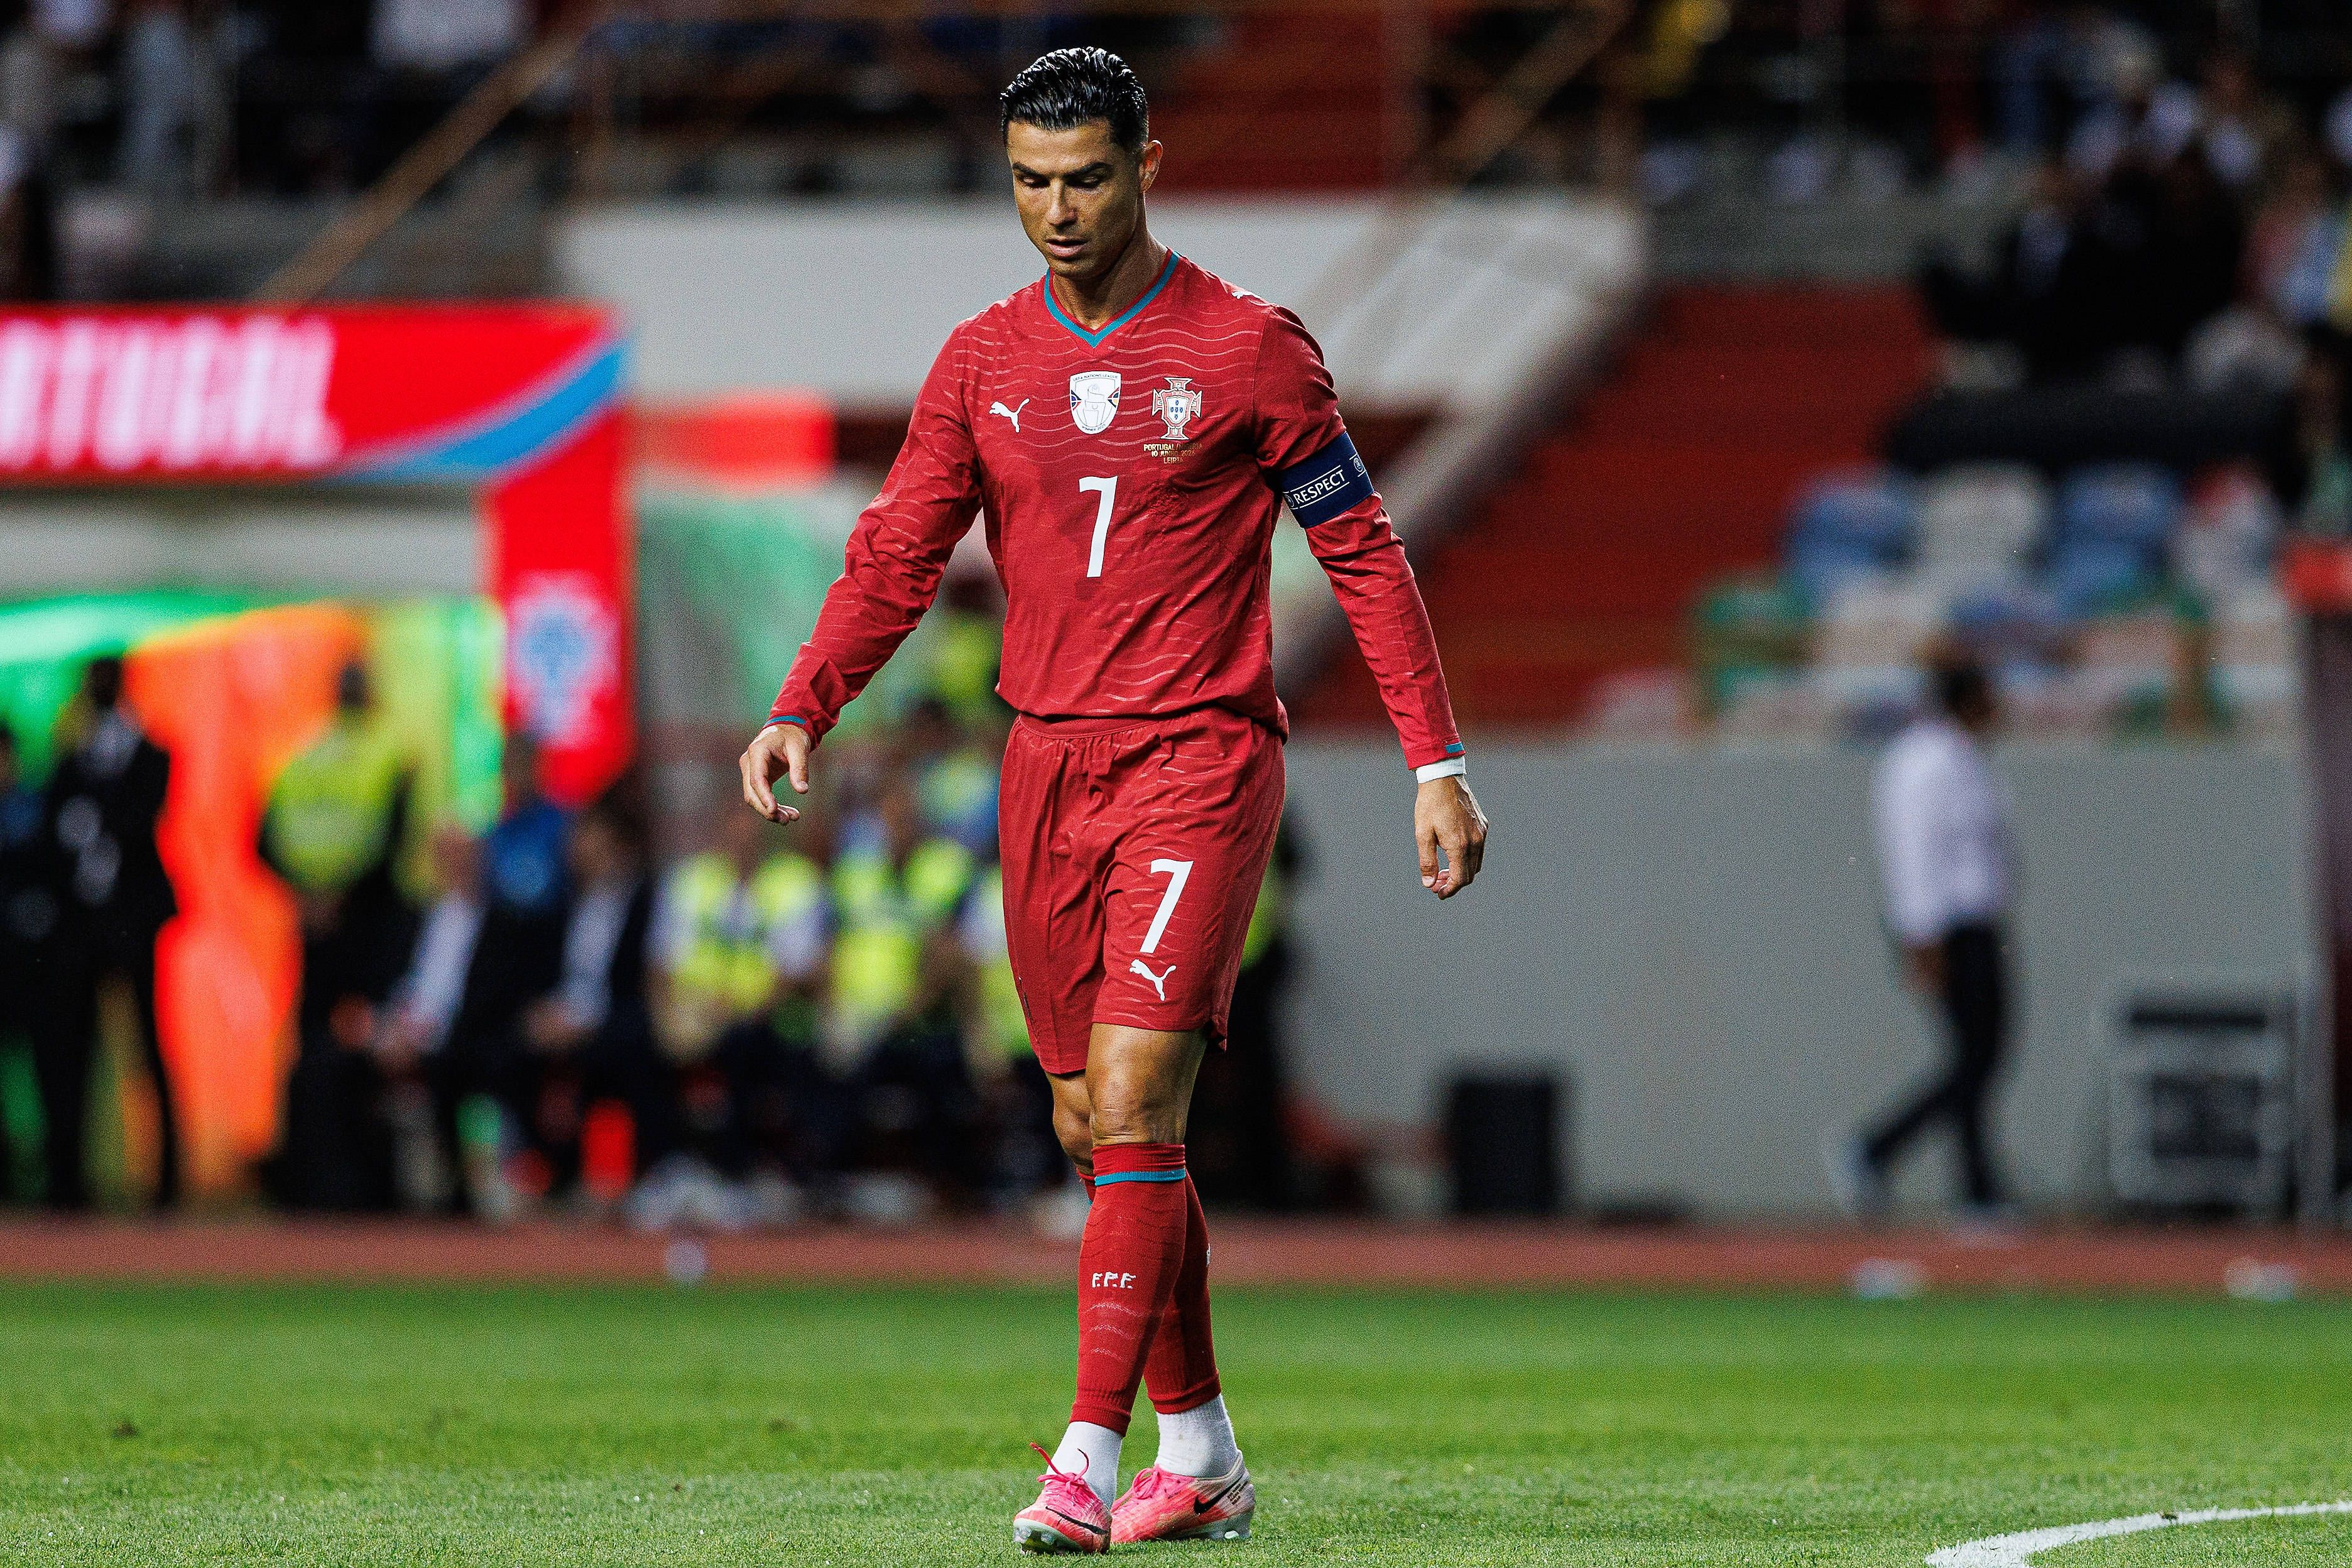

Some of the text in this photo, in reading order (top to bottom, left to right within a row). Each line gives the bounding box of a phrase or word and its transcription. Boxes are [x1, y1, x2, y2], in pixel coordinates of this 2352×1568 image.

[1079, 476, 1118, 577] 7
[1293, 469, 1345, 504] RESPECT
[1140, 858, 1194, 954] 7
